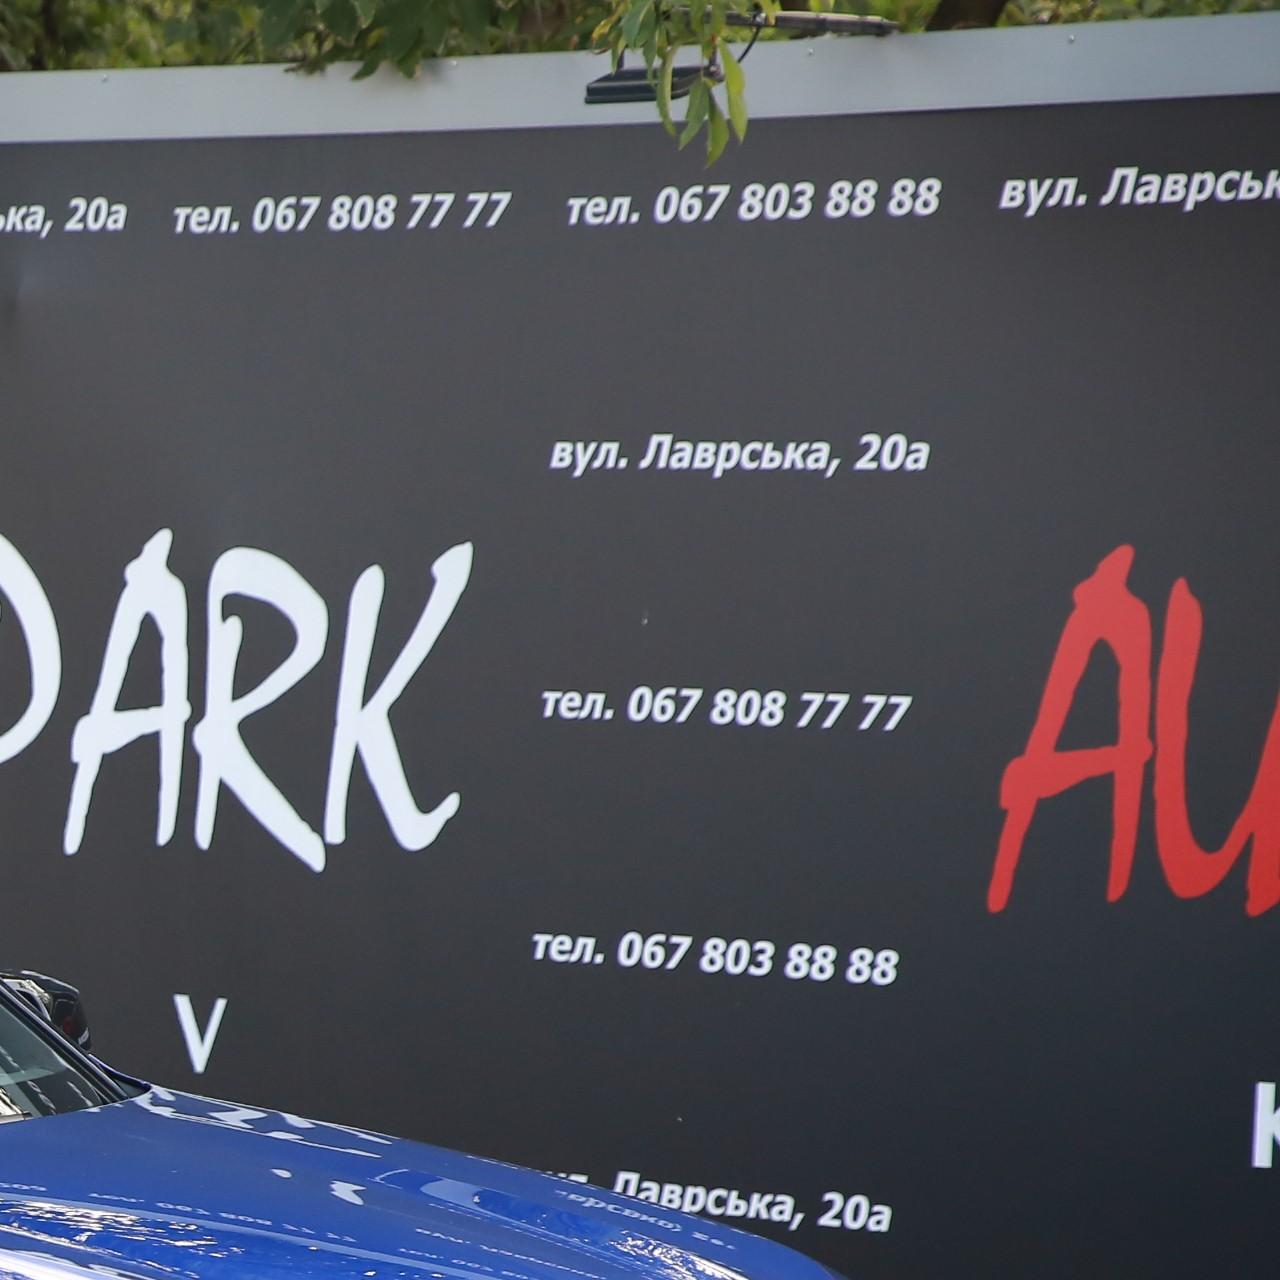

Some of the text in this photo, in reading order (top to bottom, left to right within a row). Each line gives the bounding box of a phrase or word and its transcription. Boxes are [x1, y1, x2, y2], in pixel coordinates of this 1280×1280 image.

[64, 196, 128, 232] 20а
[173, 191, 513, 234] тел. 067 808 77 77
[567, 177, 942, 226] тел. 067 803 88 88
[998, 177, 1088, 218] вул.
[549, 433, 931, 479] вул. Лаврська, 20а
[541, 685, 913, 732] тел. 067 808 77 77
[532, 931, 900, 986] тел. 067 803 88 88
[816, 1191, 893, 1233] 20а
